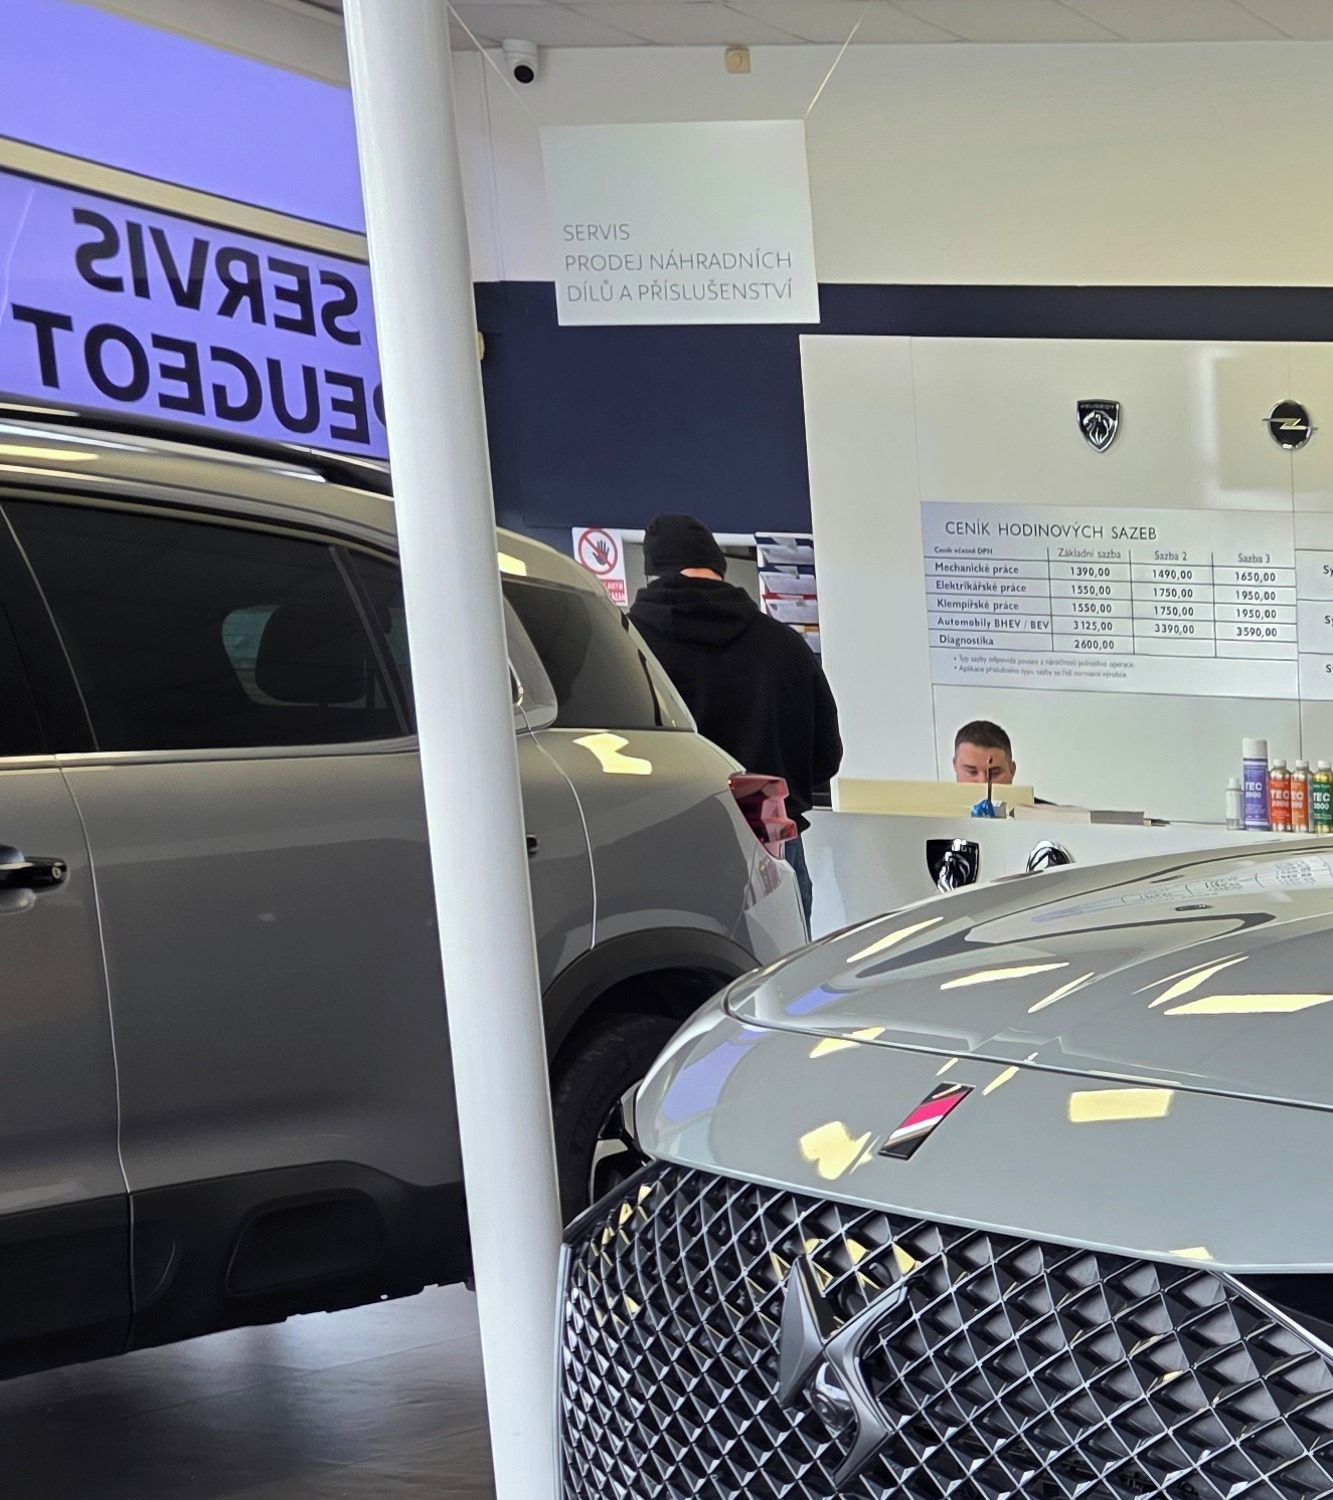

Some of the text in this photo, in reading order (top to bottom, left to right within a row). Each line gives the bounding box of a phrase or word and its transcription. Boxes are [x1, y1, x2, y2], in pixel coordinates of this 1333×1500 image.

[563, 223, 630, 242] SERVIS
[565, 247, 792, 272] PRODEJ NÁHRADNÍCH
[567, 277, 792, 302] DÍLŮ A PŘÍSLUŠENSTVÍ
[945, 518, 1157, 540] CENÍK HODINOVÝCH SAZEB
[1058, 547, 1121, 559] Základní sazba
[1154, 550, 1188, 561] Sazba 2
[1238, 552, 1271, 563] Sazba 3
[935, 562, 1020, 576] Mechanické práce
[1070, 566, 1111, 578] 1390,00
[1153, 569, 1193, 581] 1490,00
[1235, 571, 1276, 583] 1650,00
[936, 580, 1027, 594] Elektrikářské práce
[1071, 585, 1111, 596] 1550,00
[1153, 588, 1193, 599] 1750,00
[1236, 590, 1276, 602] 1950,00
[937, 598, 1019, 612] Klempířské práce
[1072, 603, 1112, 614] 1550,00
[1154, 606, 1194, 617] 1750,00
[1236, 608, 1277, 620] 1950,00
[937, 617, 991, 629] Automobily
[1030, 620, 1050, 630] BEV
[1073, 620, 1113, 632] 3125,00
[1155, 623, 1195, 635] 3390,00
[1236, 626, 1277, 638] 3590,00
[939, 634, 994, 647] Diagnostika
[1074, 639, 1115, 651] 2600,00
[1245, 781, 1262, 791] TEC
[1270, 789, 1290, 800] TEC
[1313, 792, 1331, 802] TEC
